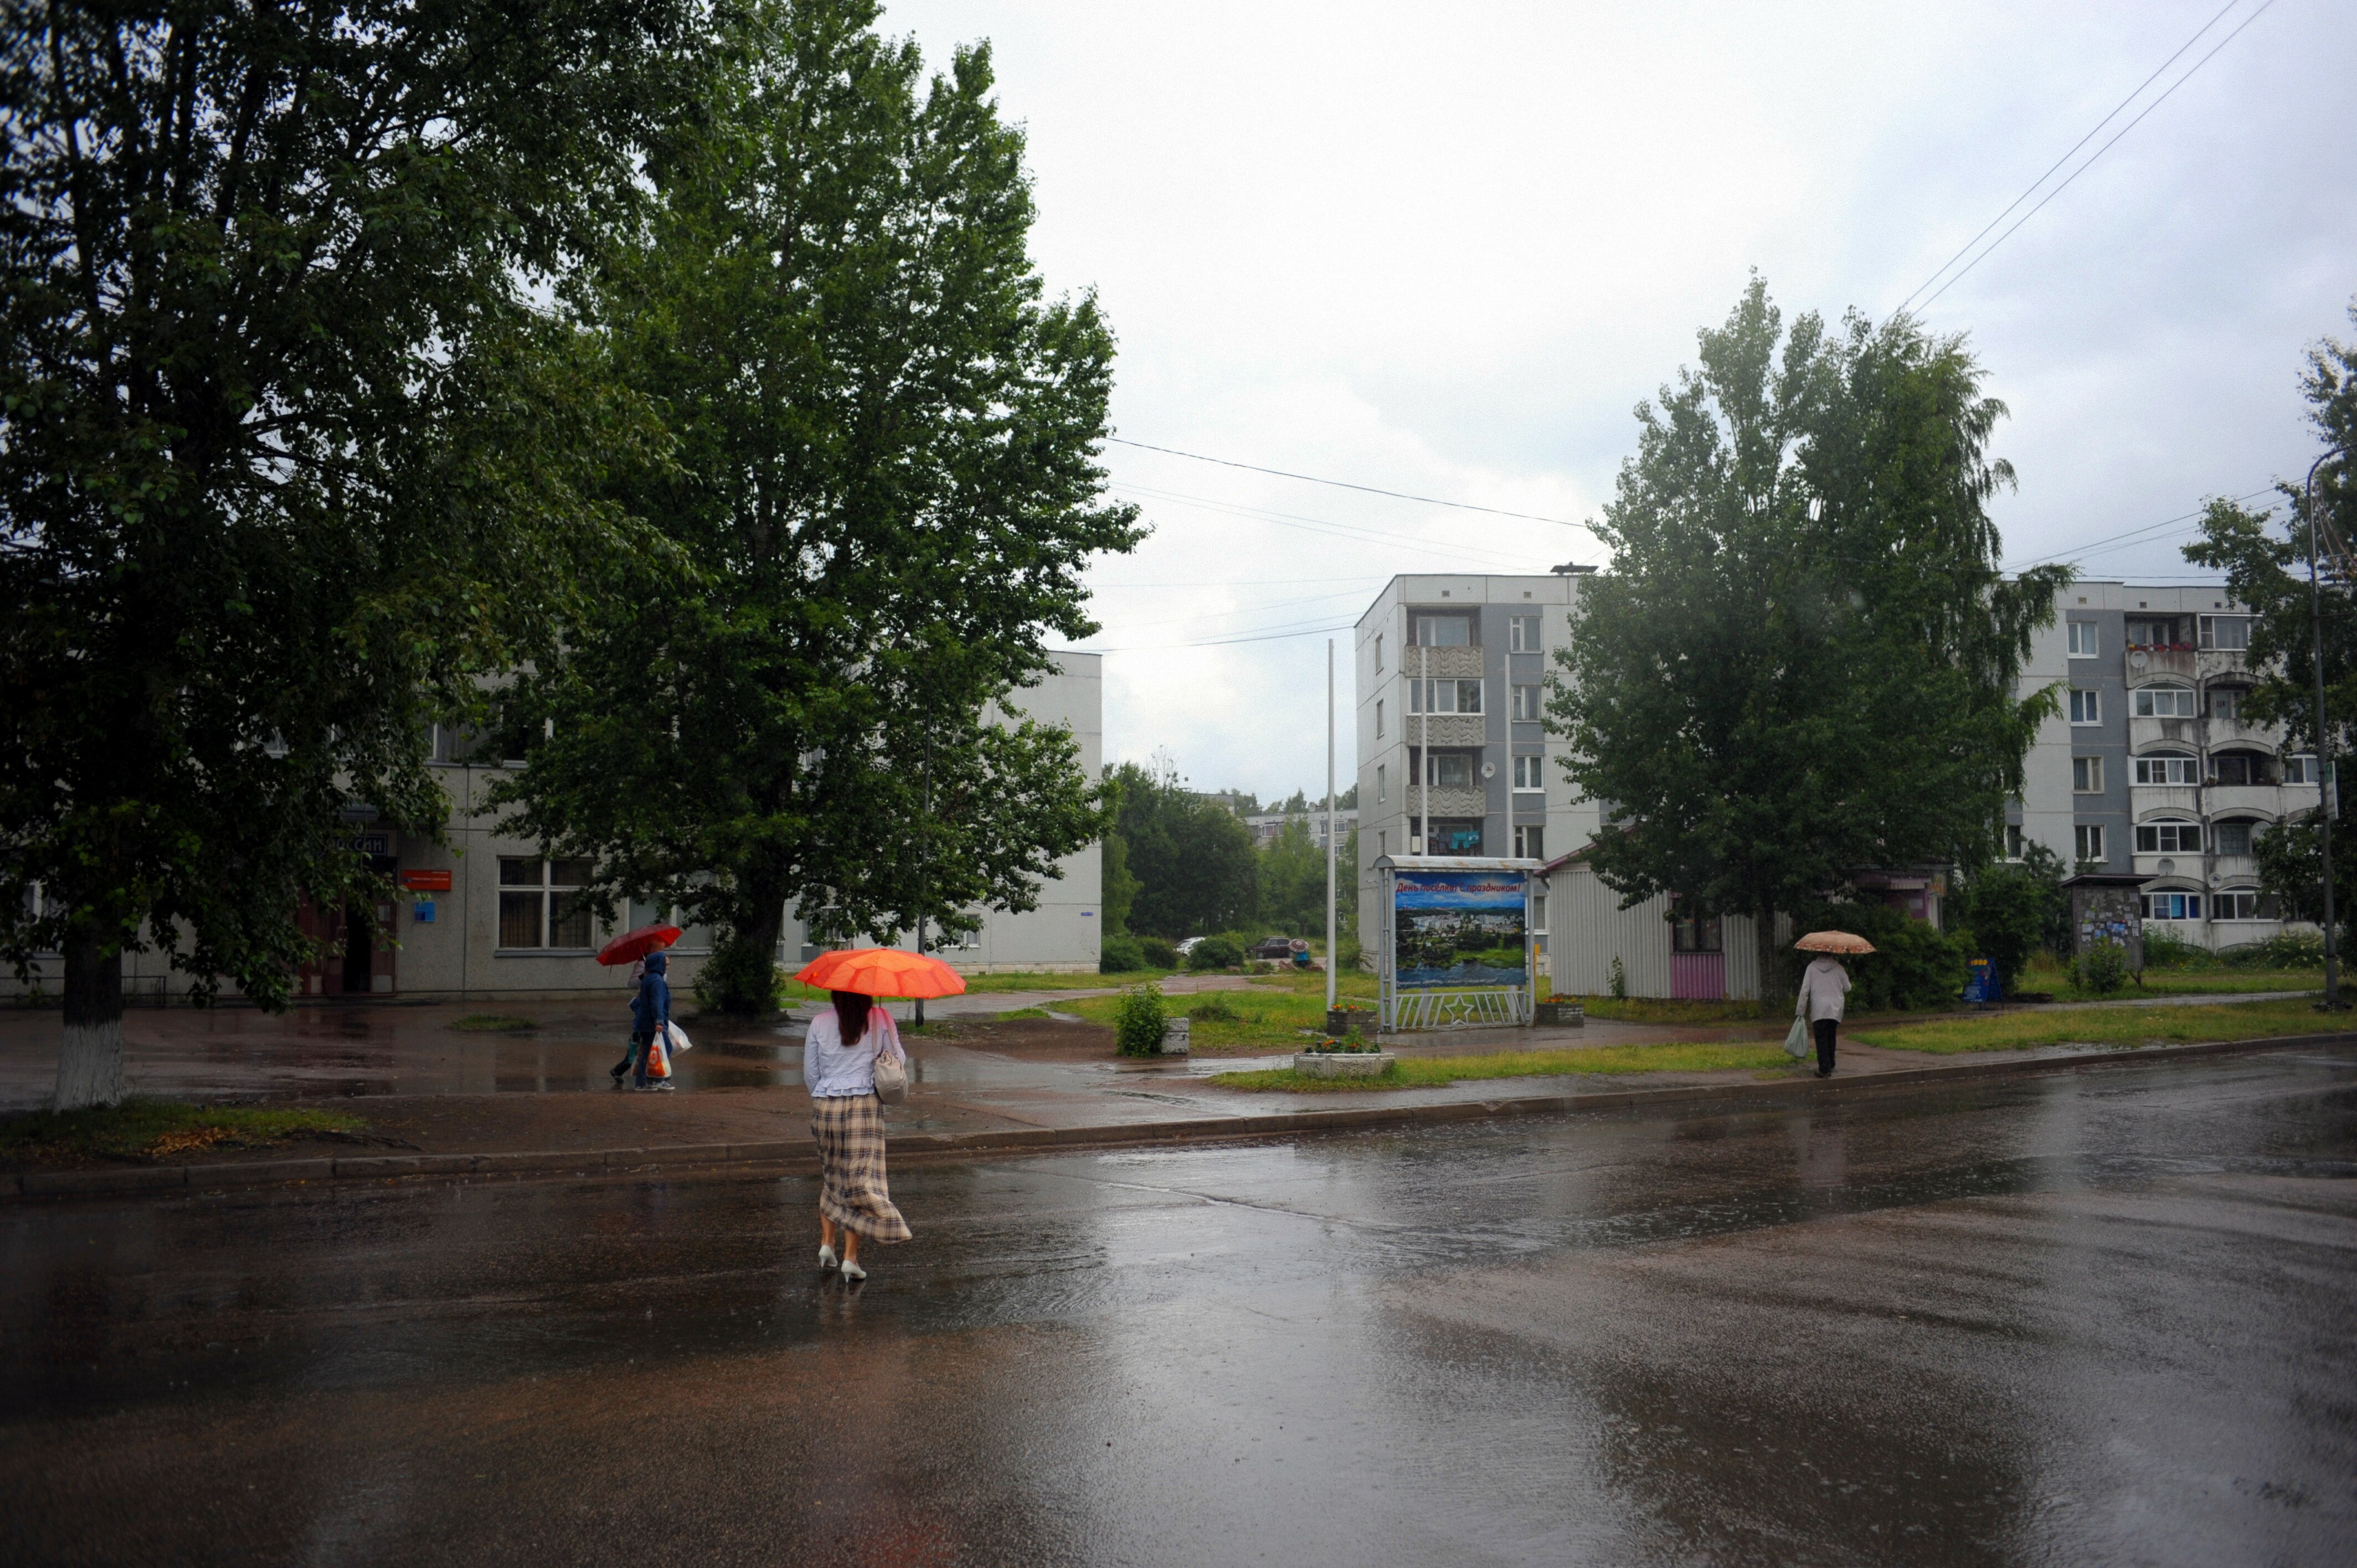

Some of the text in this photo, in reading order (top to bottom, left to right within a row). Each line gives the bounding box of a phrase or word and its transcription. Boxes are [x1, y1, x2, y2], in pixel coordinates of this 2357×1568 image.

[1396, 882, 1520, 894] День посёлка! С праздником!
